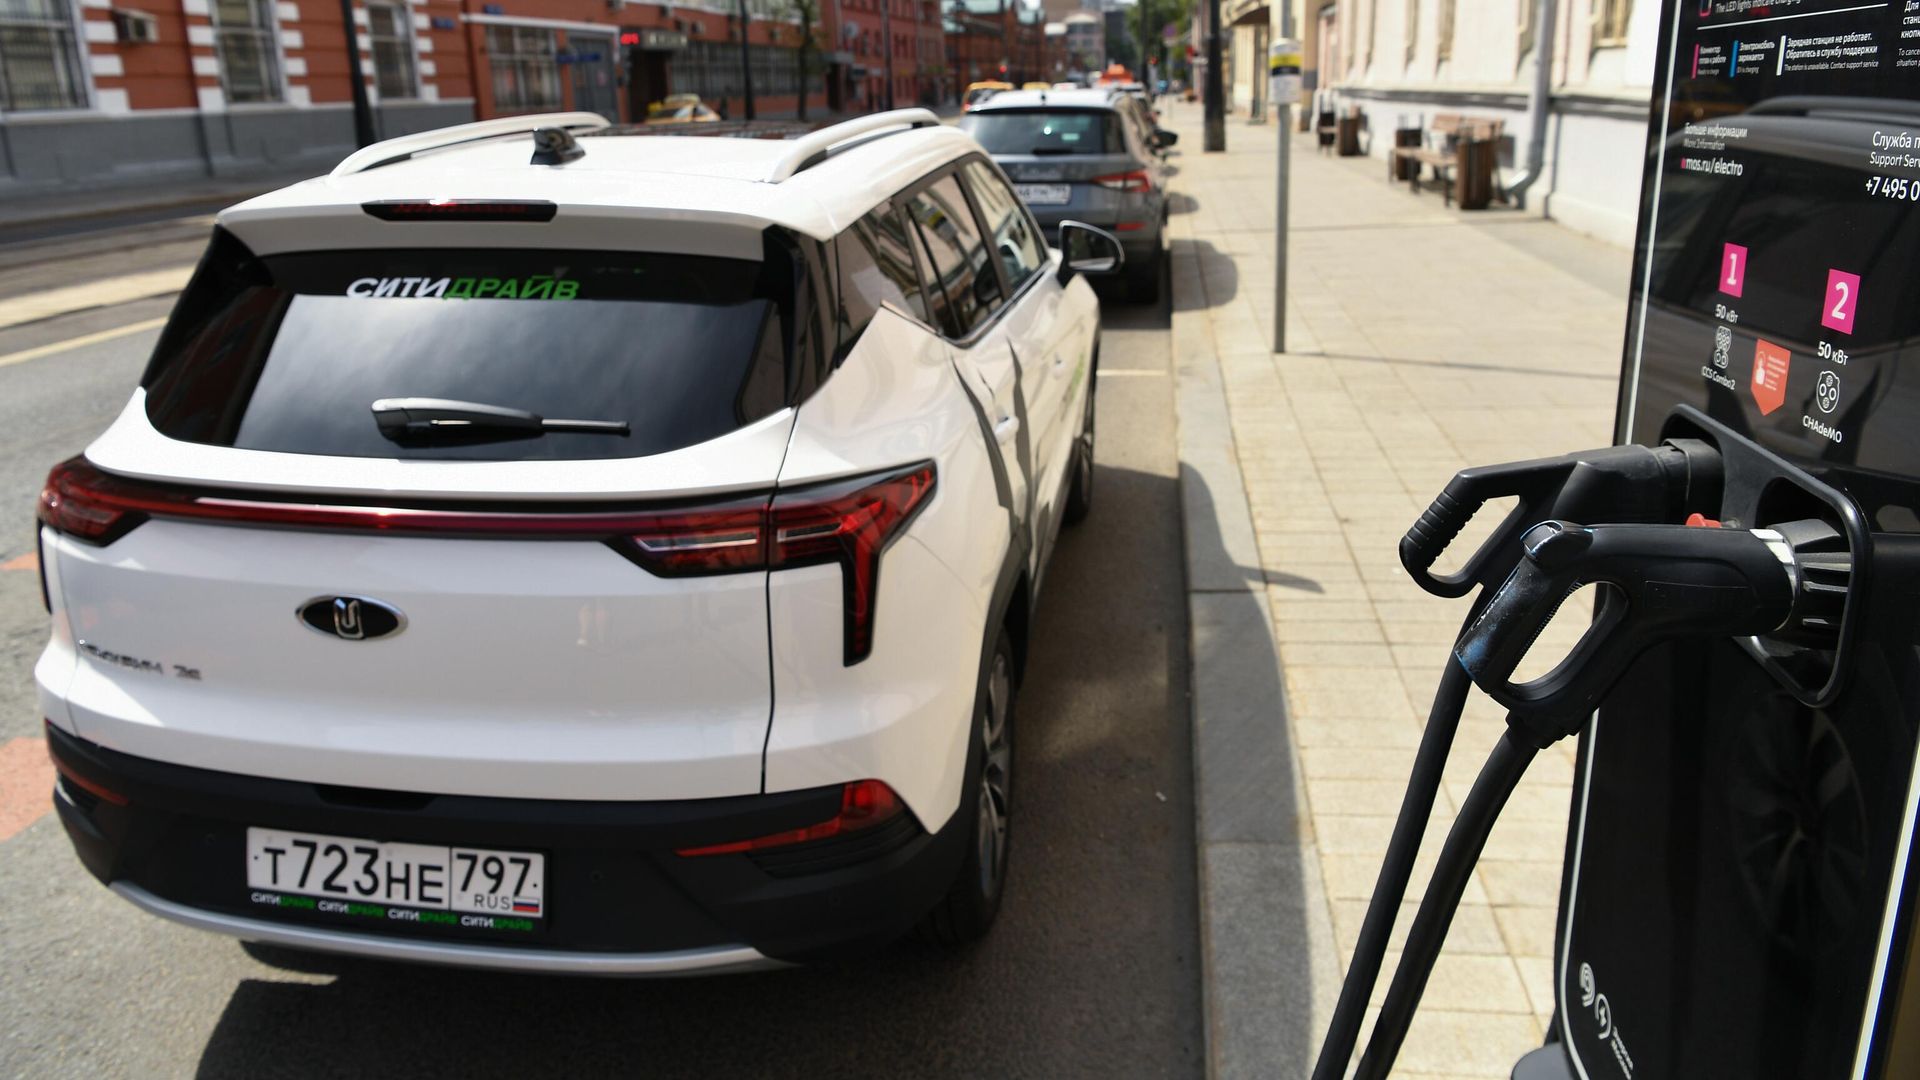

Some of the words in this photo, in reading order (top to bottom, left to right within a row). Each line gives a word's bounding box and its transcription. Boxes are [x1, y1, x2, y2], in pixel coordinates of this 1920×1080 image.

[1716, 3, 1725, 13] The
[1726, 1, 1737, 12] LED
[1904, 0, 1920, 13] Для
[1787, 38, 1812, 48] Зарядная
[1812, 36, 1835, 45] станция
[1835, 35, 1843, 43] не
[1843, 32, 1873, 45] работает.
[1786, 49, 1816, 60] Обратитесь
[1821, 46, 1842, 59] службу
[1842, 46, 1878, 56] поддержки
[1830, 61, 1846, 70] Contact
[1846, 61, 1862, 71] support
[1863, 60, 1879, 69] service
[1707, 123, 1748, 139] информации
[1873, 131, 1912, 151] Служба
[1686, 157, 1743, 176] mos.ru/electro
[1870, 151, 1903, 168] Support
[1865, 176, 1881, 196] +7
[1881, 178, 1908, 200] 495
[1727, 253, 1737, 286] 1
[346, 275, 580, 300] СИТИДРАЙВ
[1831, 281, 1849, 320] 2
[1715, 303, 1726, 319] 50
[1726, 310, 1738, 323] кВт
[1817, 341, 1832, 359] 50
[1832, 349, 1848, 365] кВт
[1701, 366, 1713, 379] CCS
[1803, 415, 1842, 443] CHAdeMO
[456, 853, 532, 897] 797
[473, 894, 511, 910] RUS
